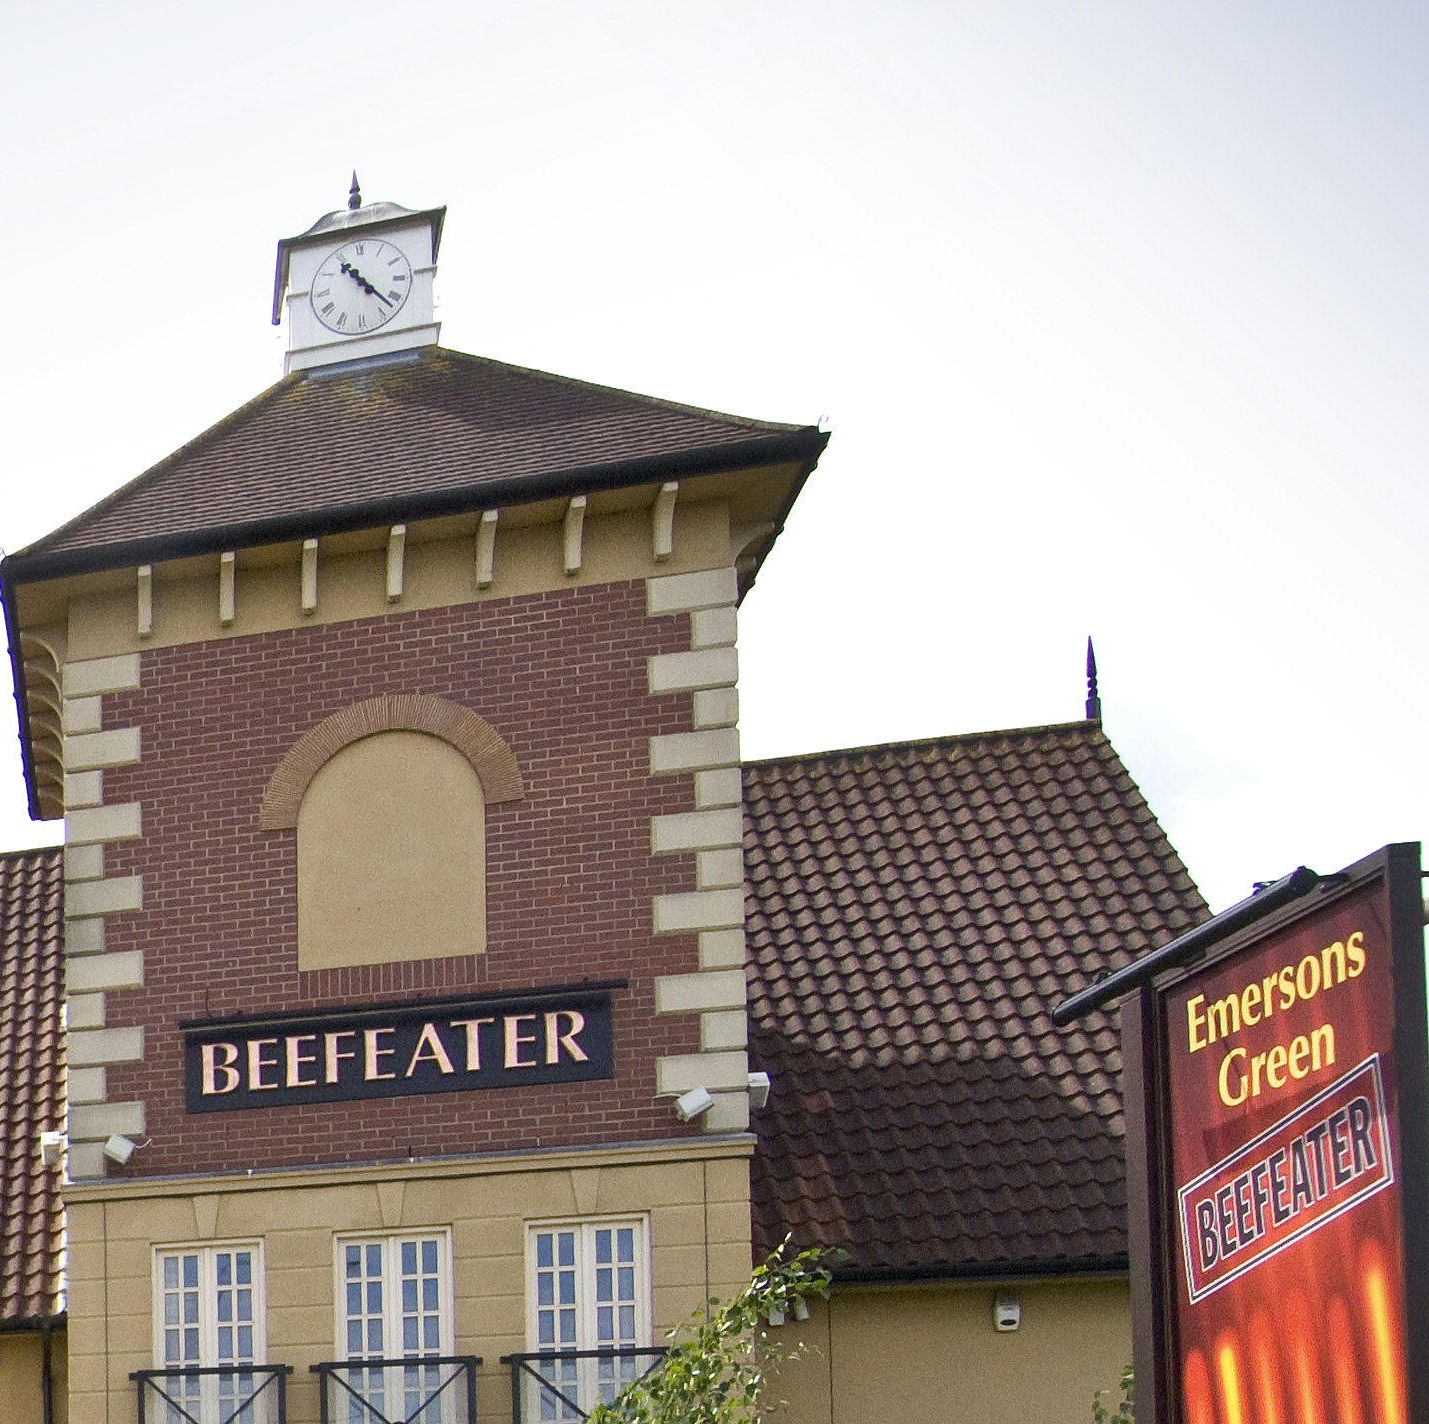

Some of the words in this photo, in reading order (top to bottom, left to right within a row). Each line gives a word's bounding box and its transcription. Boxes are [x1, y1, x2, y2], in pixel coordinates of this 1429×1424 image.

[1186, 931, 1367, 1053] Emersons
[201, 1009, 589, 1096] BEEFEATER
[1218, 1023, 1336, 1107] Green
[1194, 1096, 1378, 1271] BEEFEATER
